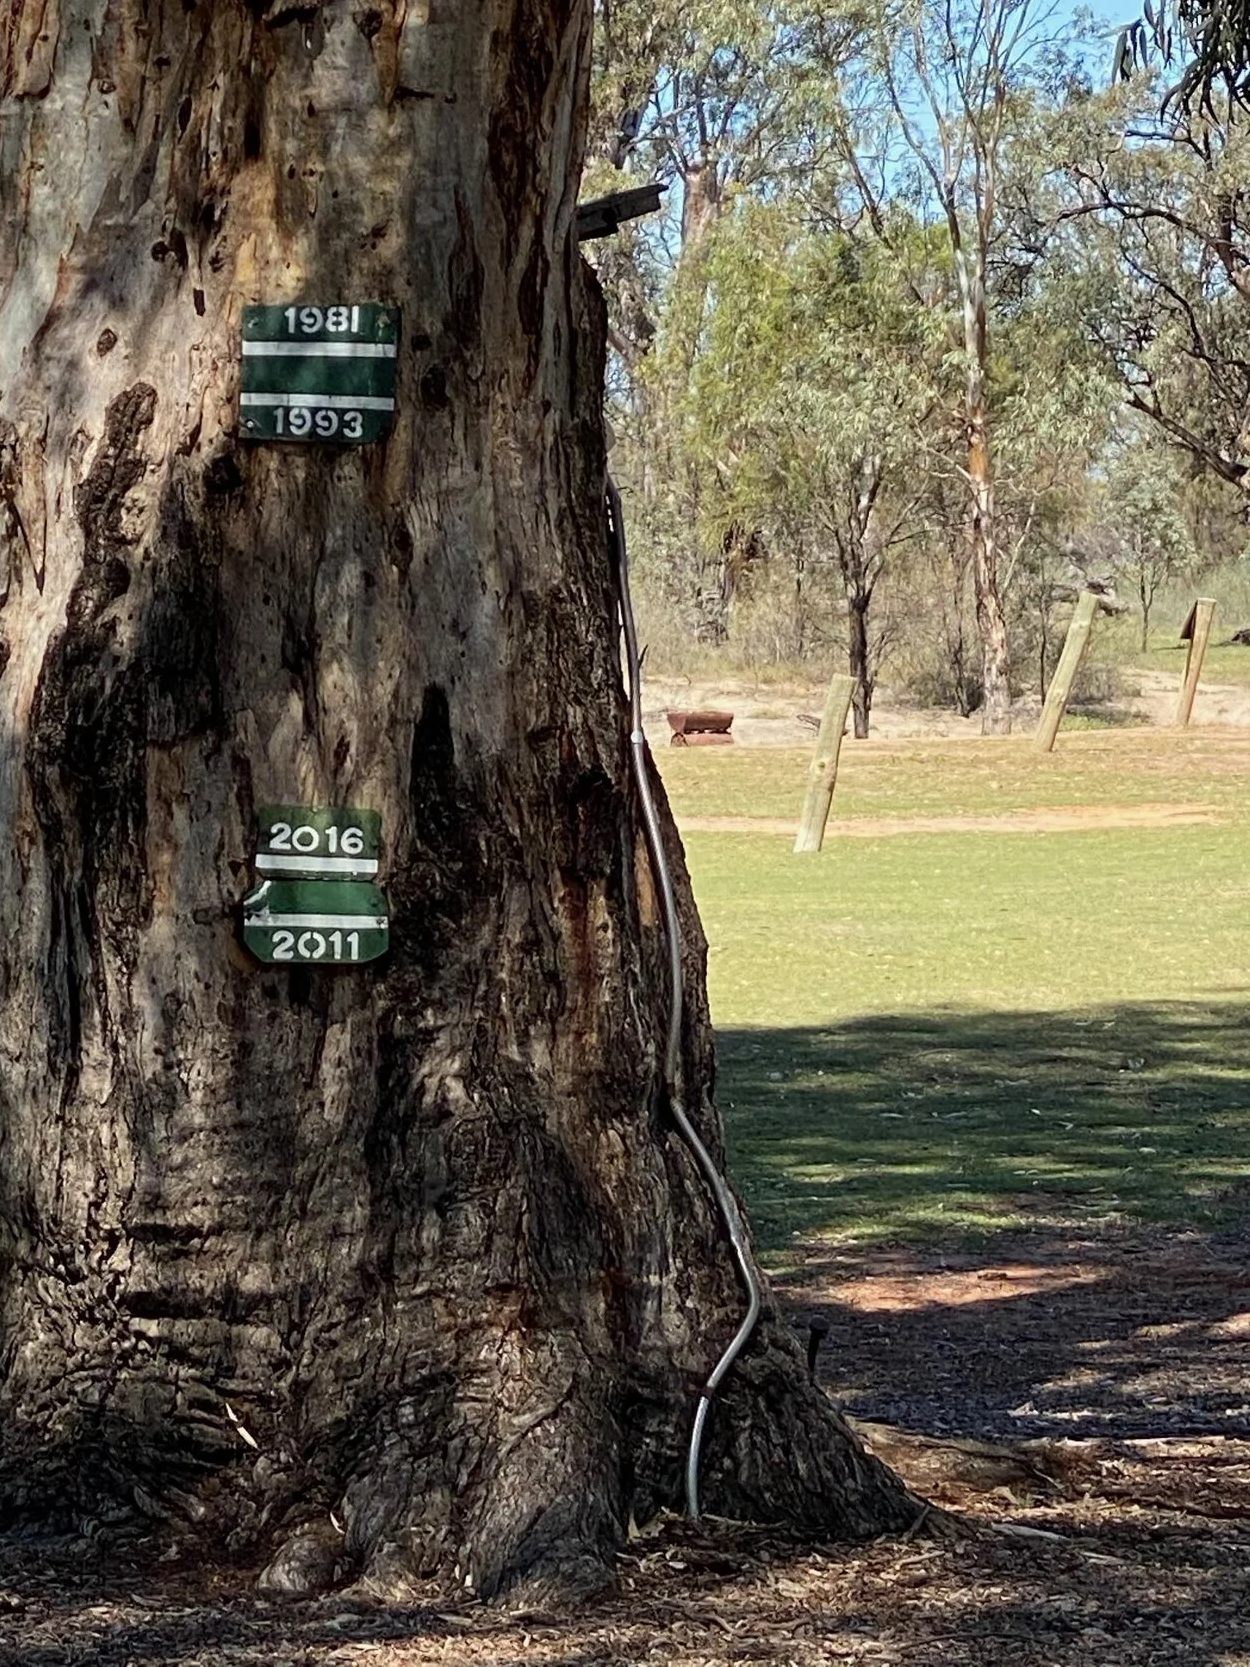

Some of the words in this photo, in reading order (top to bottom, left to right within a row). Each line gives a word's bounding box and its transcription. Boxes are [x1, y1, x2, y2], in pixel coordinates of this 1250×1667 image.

[284, 305, 360, 334] 1981
[272, 406, 364, 439] 1993
[268, 821, 365, 855] 2016
[271, 929, 360, 961] 2011
